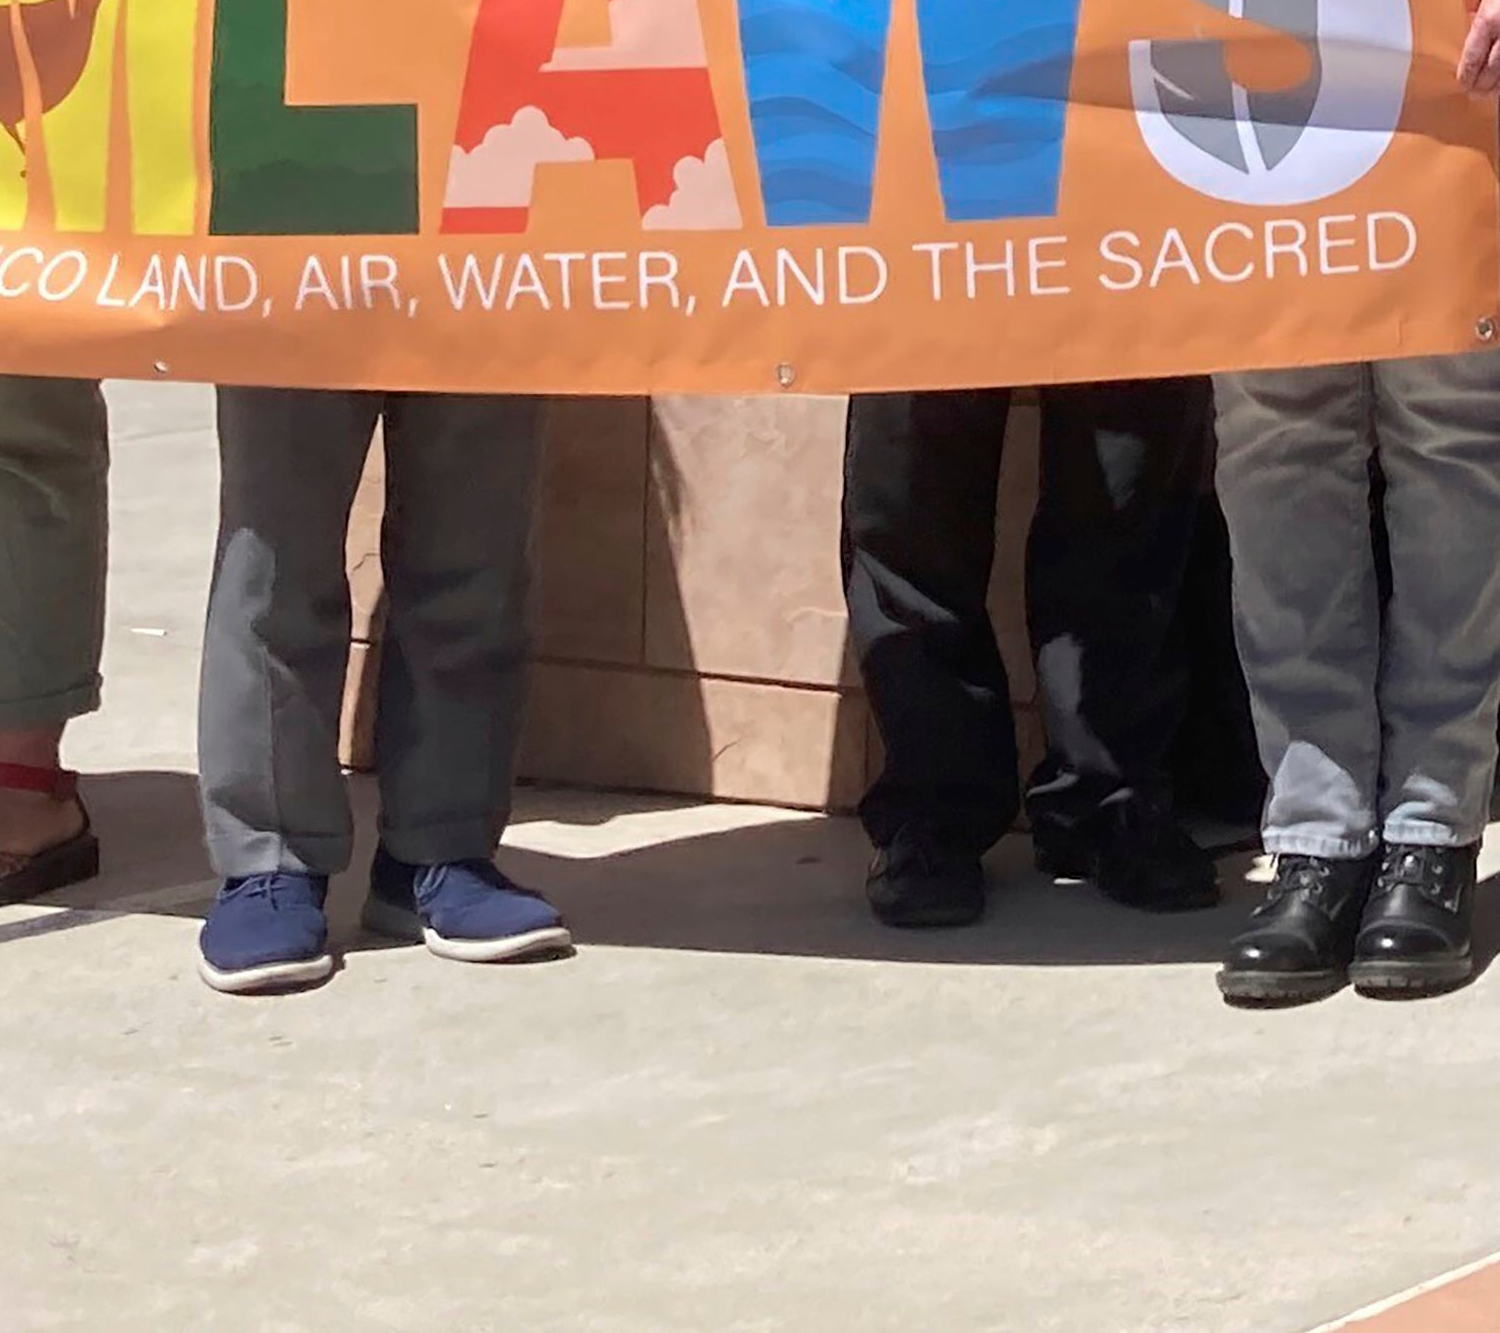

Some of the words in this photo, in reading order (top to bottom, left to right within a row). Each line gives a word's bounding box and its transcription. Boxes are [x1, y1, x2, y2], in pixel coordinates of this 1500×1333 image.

[96, 252, 273, 319] LAND,
[294, 252, 421, 319] AIR,
[438, 249, 698, 318] WATER,
[720, 247, 890, 310] AND
[911, 235, 1073, 304] THE
[1098, 209, 1418, 292] SACRED
